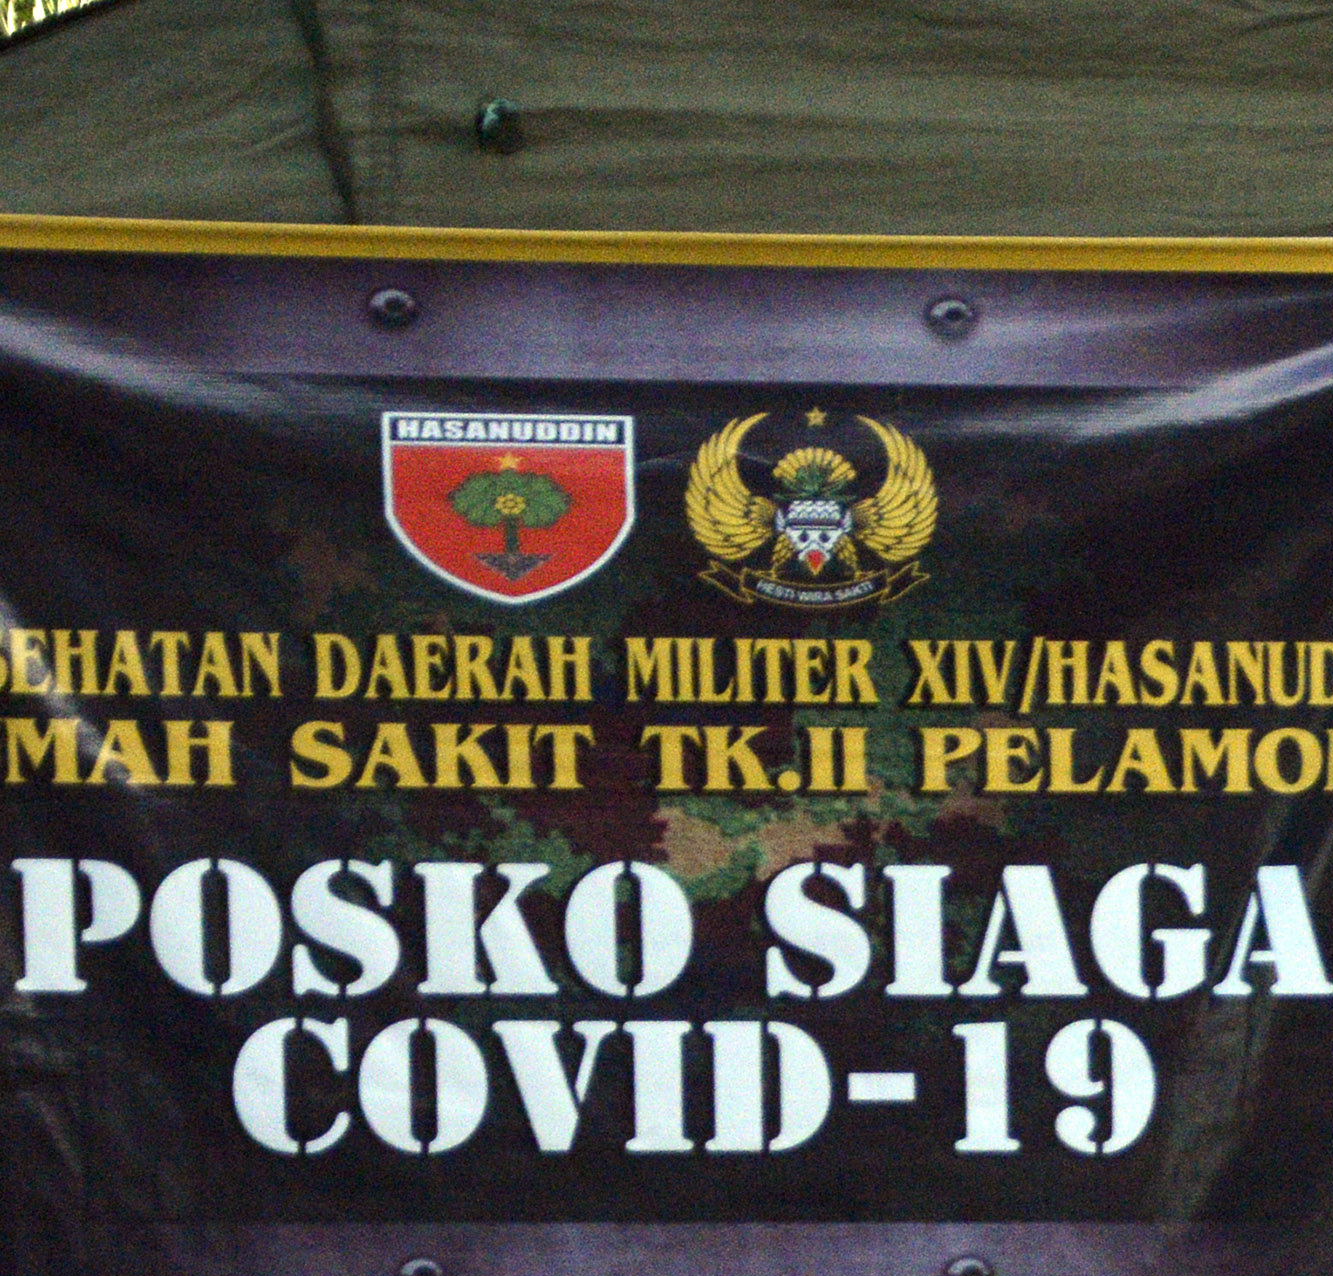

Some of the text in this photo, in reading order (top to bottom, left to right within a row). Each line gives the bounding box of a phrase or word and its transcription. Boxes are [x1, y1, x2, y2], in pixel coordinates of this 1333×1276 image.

[397, 420, 617, 442] HASANUDDIN
[756, 580, 874, 602] HESTI WIRA SAKTI
[314, 633, 592, 701] DAERAH
[626, 637, 879, 703] MILITER
[290, 721, 594, 789] SAKIT
[641, 726, 872, 792] TK.II
[12, 858, 694, 996] POSKO
[232, 1017, 1156, 1154] COVID-19
